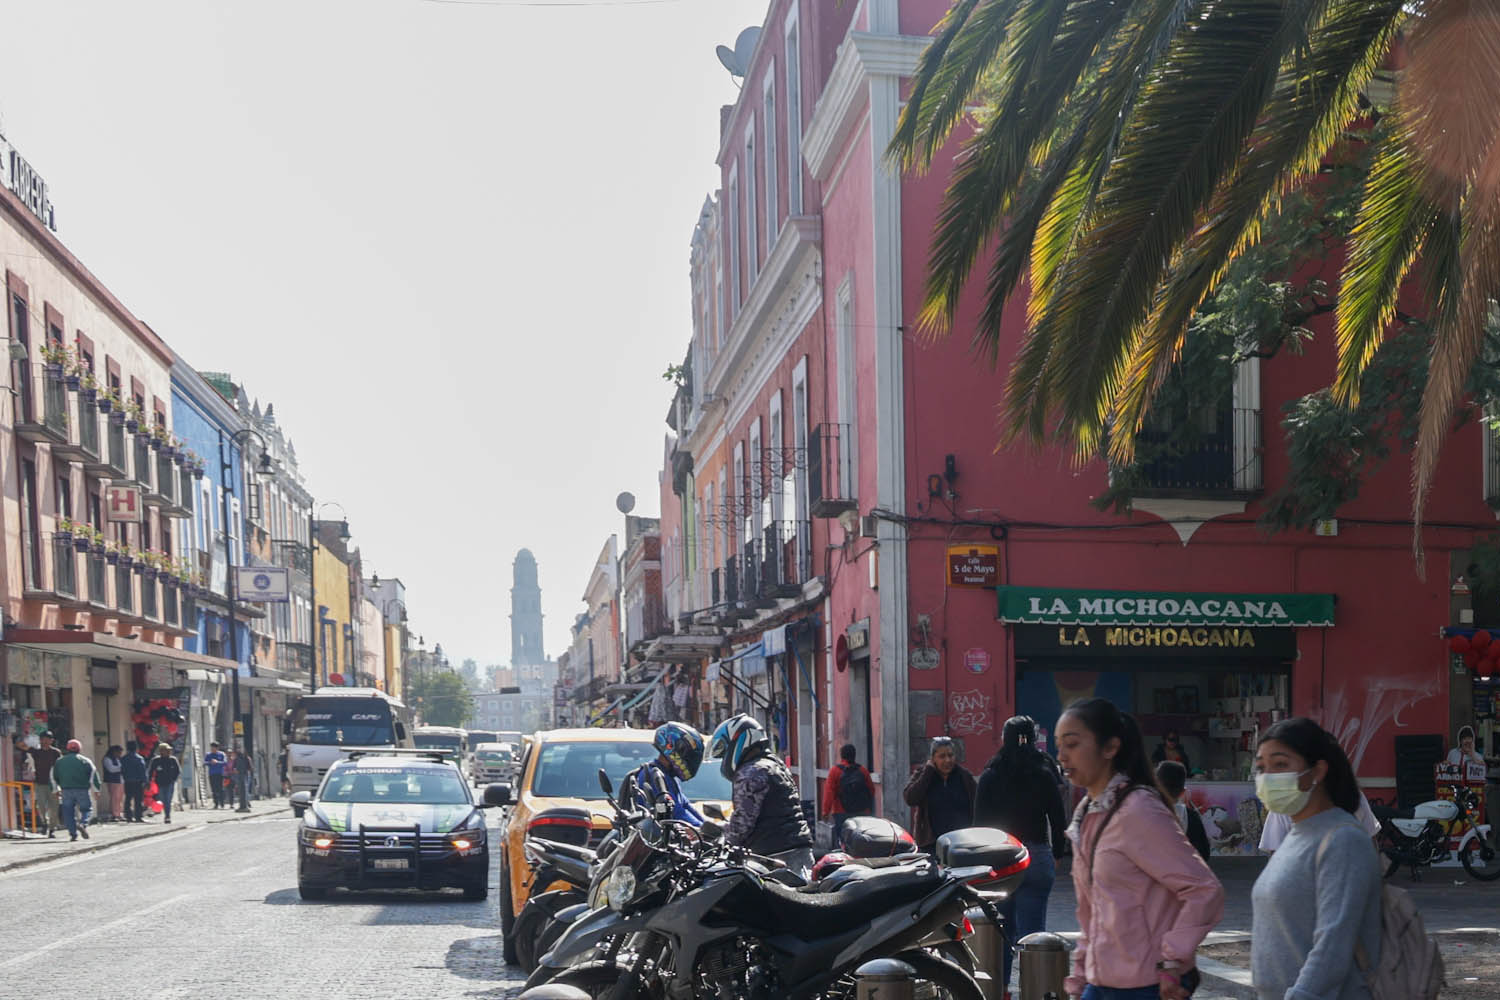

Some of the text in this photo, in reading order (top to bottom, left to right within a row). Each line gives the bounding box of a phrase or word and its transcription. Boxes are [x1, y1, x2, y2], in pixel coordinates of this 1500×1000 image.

[112, 489, 135, 512] H
[953, 563, 996, 576] 5 de Mayo
[1028, 596, 1288, 619] LA MICHOACANA
[1058, 627, 1256, 649] LA MICHOACANA
